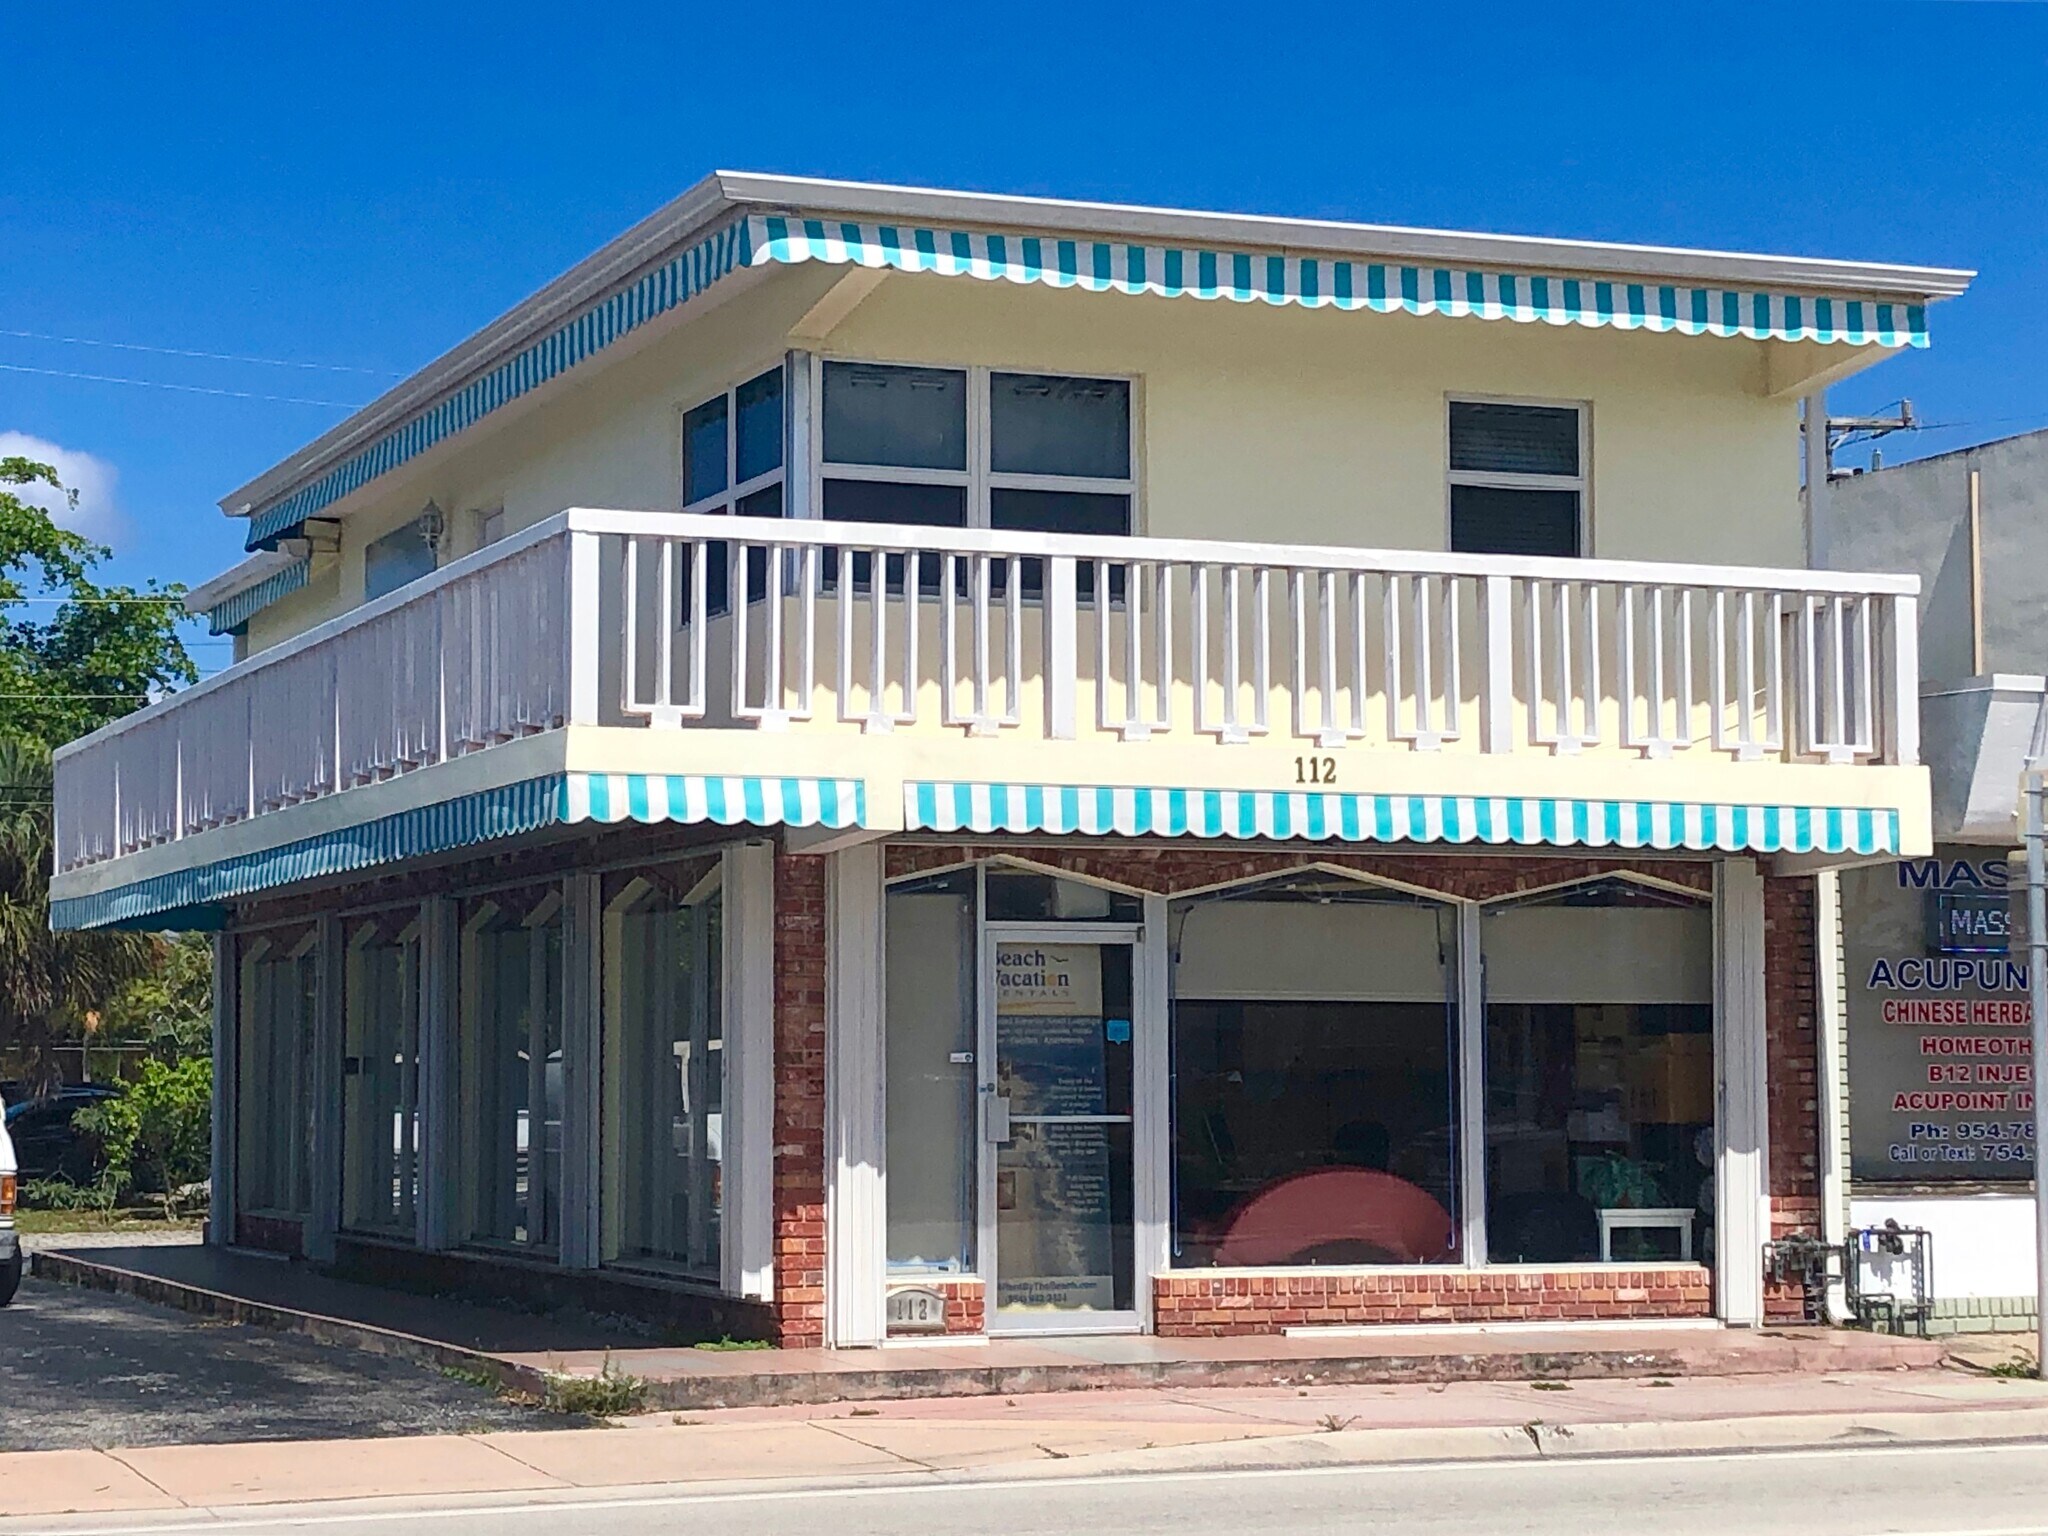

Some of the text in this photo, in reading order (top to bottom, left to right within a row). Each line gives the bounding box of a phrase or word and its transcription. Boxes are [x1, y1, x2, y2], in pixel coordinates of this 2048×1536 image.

[1295, 757, 1336, 783] 112
[1898, 860, 2008, 888] MAS
[1868, 958, 2030, 991] ACUPUN
[1882, 1001, 1967, 1023] CHINESE
[1921, 1038, 2032, 1055] HOMEOTH
[1929, 1065, 2033, 1083] B12 INJE
[1893, 1093, 2008, 1111] ACUPOINT
[1910, 1122, 1949, 1139] Ph:
[1890, 1145, 1917, 1161] Call
[1922, 1148, 1937, 1161] or
[1940, 1145, 1976, 1161] Text:
[897, 1298, 928, 1321] 112
